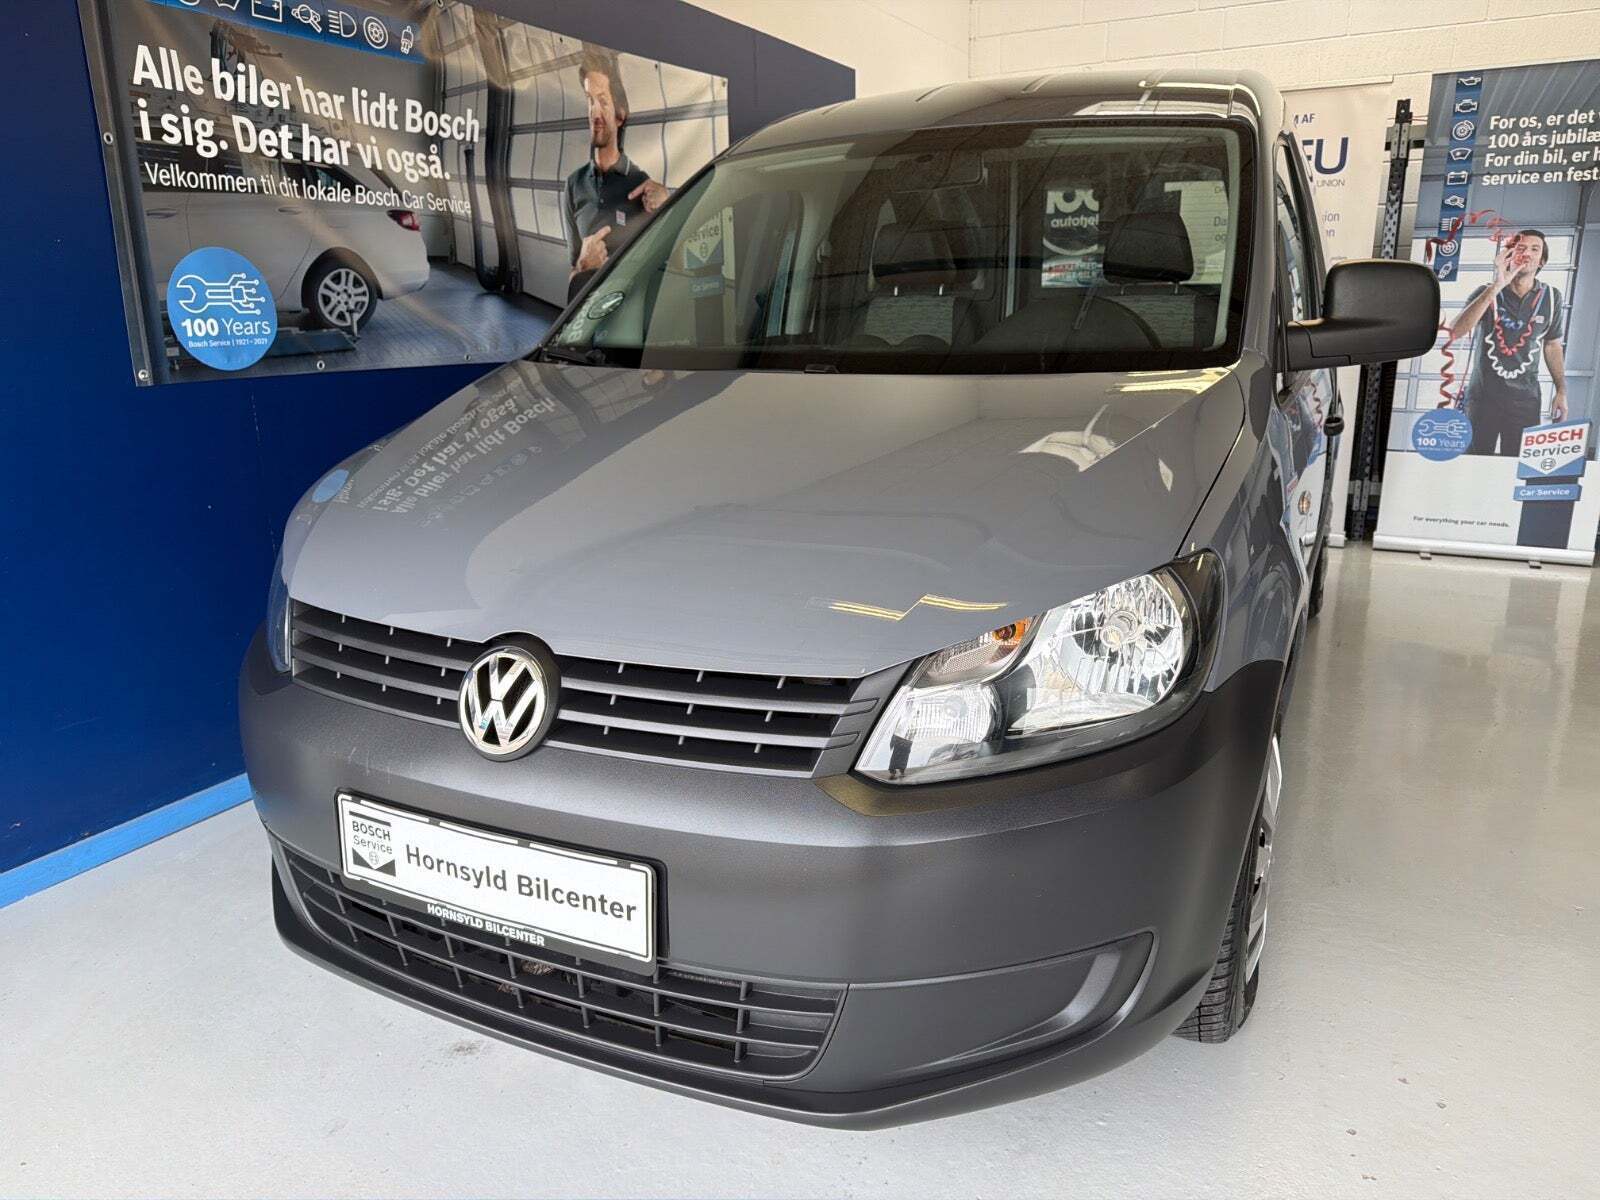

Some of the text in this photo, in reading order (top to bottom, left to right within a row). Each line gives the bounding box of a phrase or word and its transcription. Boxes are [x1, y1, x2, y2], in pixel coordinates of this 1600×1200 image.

[133, 45, 480, 143] Alle biler har lidt Bosch
[1301, 113, 1316, 123] AF
[1489, 109, 1595, 130] For os, er det
[137, 98, 450, 183] i sig. Det har vi også.
[1488, 133, 1519, 149] 100
[1522, 131, 1548, 147] års
[1485, 152, 1511, 167] For
[1514, 150, 1539, 166] din
[1543, 148, 1567, 165] bil,
[1571, 150, 1590, 162] er
[1481, 170, 1540, 186] service
[1543, 170, 1563, 183] en
[144, 162, 472, 214] Velkommen til dit lokale Bosch Car Service
[181, 318, 271, 337] 100 Years
[189, 340, 208, 348] Bosch
[1417, 437, 1465, 448] 100 Years
[1524, 428, 1584, 446] BOSCH
[1522, 444, 1581, 458] Service
[1520, 488, 1570, 497] Car Service
[352, 820, 391, 841] BOSCH
[353, 834, 393, 855] Service
[406, 844, 637, 922] Hornsyld Bilcenter
[427, 903, 545, 947] HORNSYLD BILCENTER
